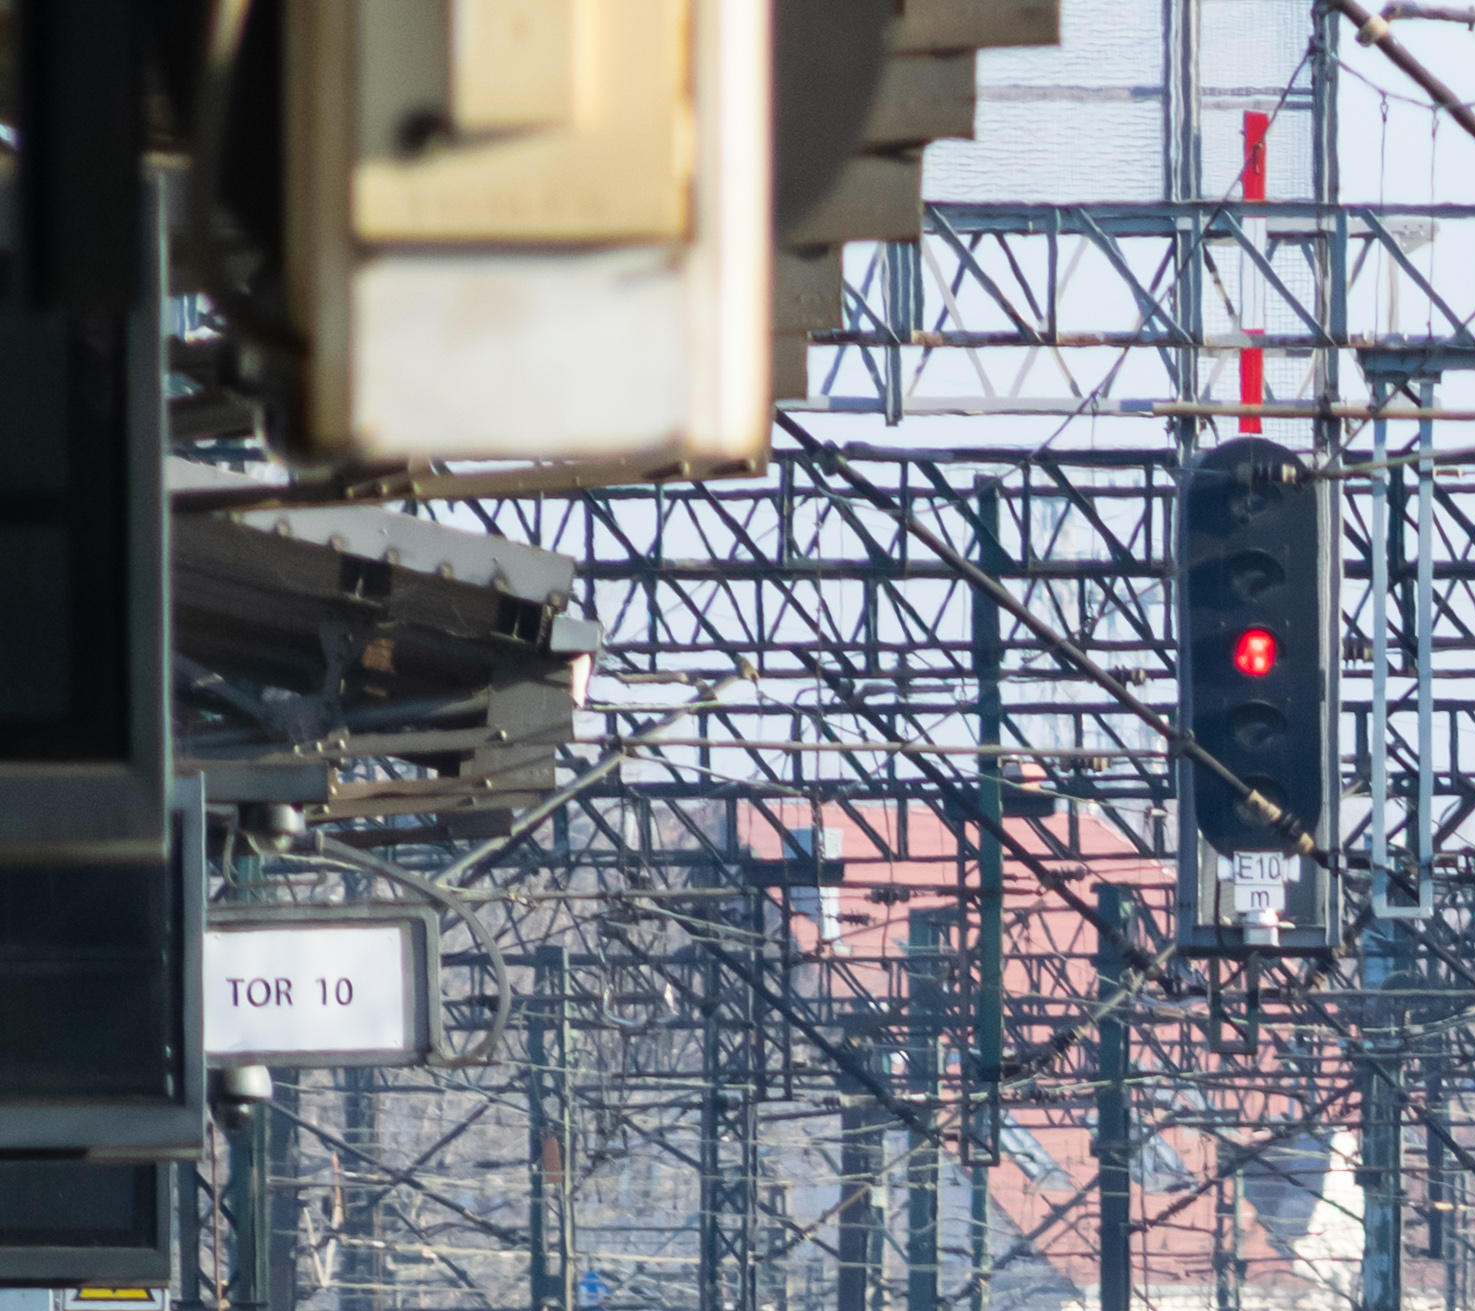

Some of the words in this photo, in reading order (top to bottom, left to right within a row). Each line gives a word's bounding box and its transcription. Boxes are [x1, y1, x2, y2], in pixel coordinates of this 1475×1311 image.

[1237, 855, 1281, 880] E10
[1250, 890, 1270, 908] m
[225, 976, 294, 1008] TOR
[315, 976, 354, 1007] 10
